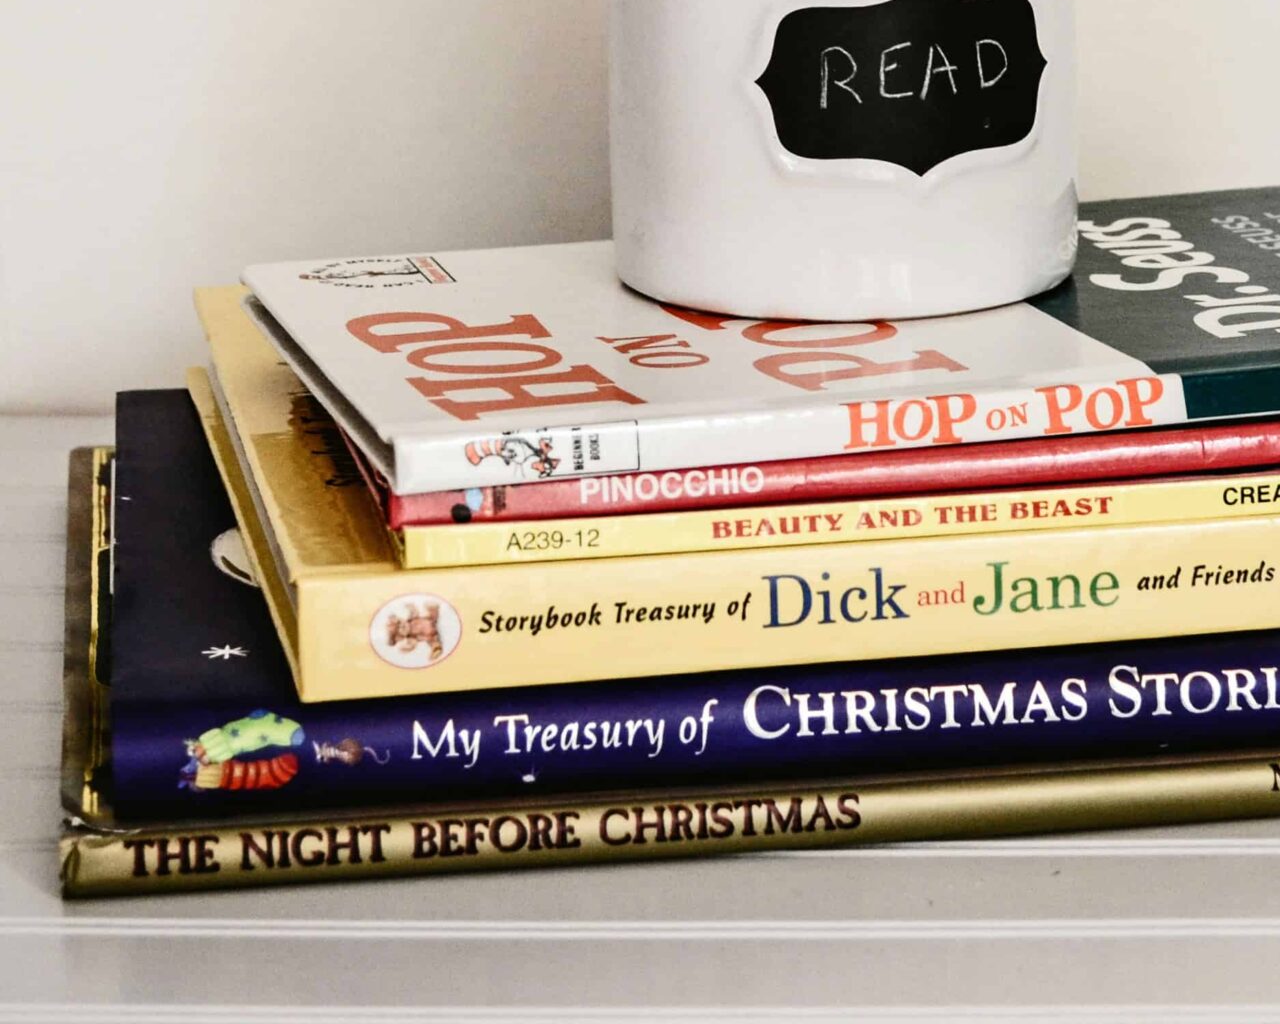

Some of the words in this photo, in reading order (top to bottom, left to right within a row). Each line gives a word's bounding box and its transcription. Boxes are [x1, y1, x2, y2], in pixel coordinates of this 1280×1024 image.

[820, 39, 1007, 109] READ
[1078, 217, 1249, 291] Seuss
[346, 311, 648, 421] HOP
[596, 333, 710, 369] ON
[659, 304, 970, 391] OP
[571, 427, 584, 471] BEGINN
[839, 393, 976, 450] HOP
[986, 403, 1029, 431] ON
[1035, 377, 1164, 435] POP
[579, 466, 765, 505] PINOCCHIO
[712, 512, 844, 539] BEAUTY
[855, 507, 922, 531] AND
[934, 503, 998, 524] THE
[1010, 495, 1114, 520] BEAST
[506, 528, 600, 551] A239-12
[479, 603, 601, 635] Storybook
[614, 596, 716, 624] Treasury
[727, 592, 752, 621] of
[761, 567, 910, 629] Dick
[917, 582, 966, 607] and
[972, 562, 1119, 616] Jane
[1137, 566, 1180, 591] and
[1190, 561, 1275, 587] Friends
[411, 718, 482, 768] My
[494, 713, 666, 758] Treasury
[678, 698, 719, 755] of
[743, 684, 1089, 740] CHRISTMAS
[123, 834, 220, 877] THE
[241, 824, 391, 870] NIGHT
[411, 810, 582, 860] BEFORE
[600, 793, 862, 847] CHRISTMAS
